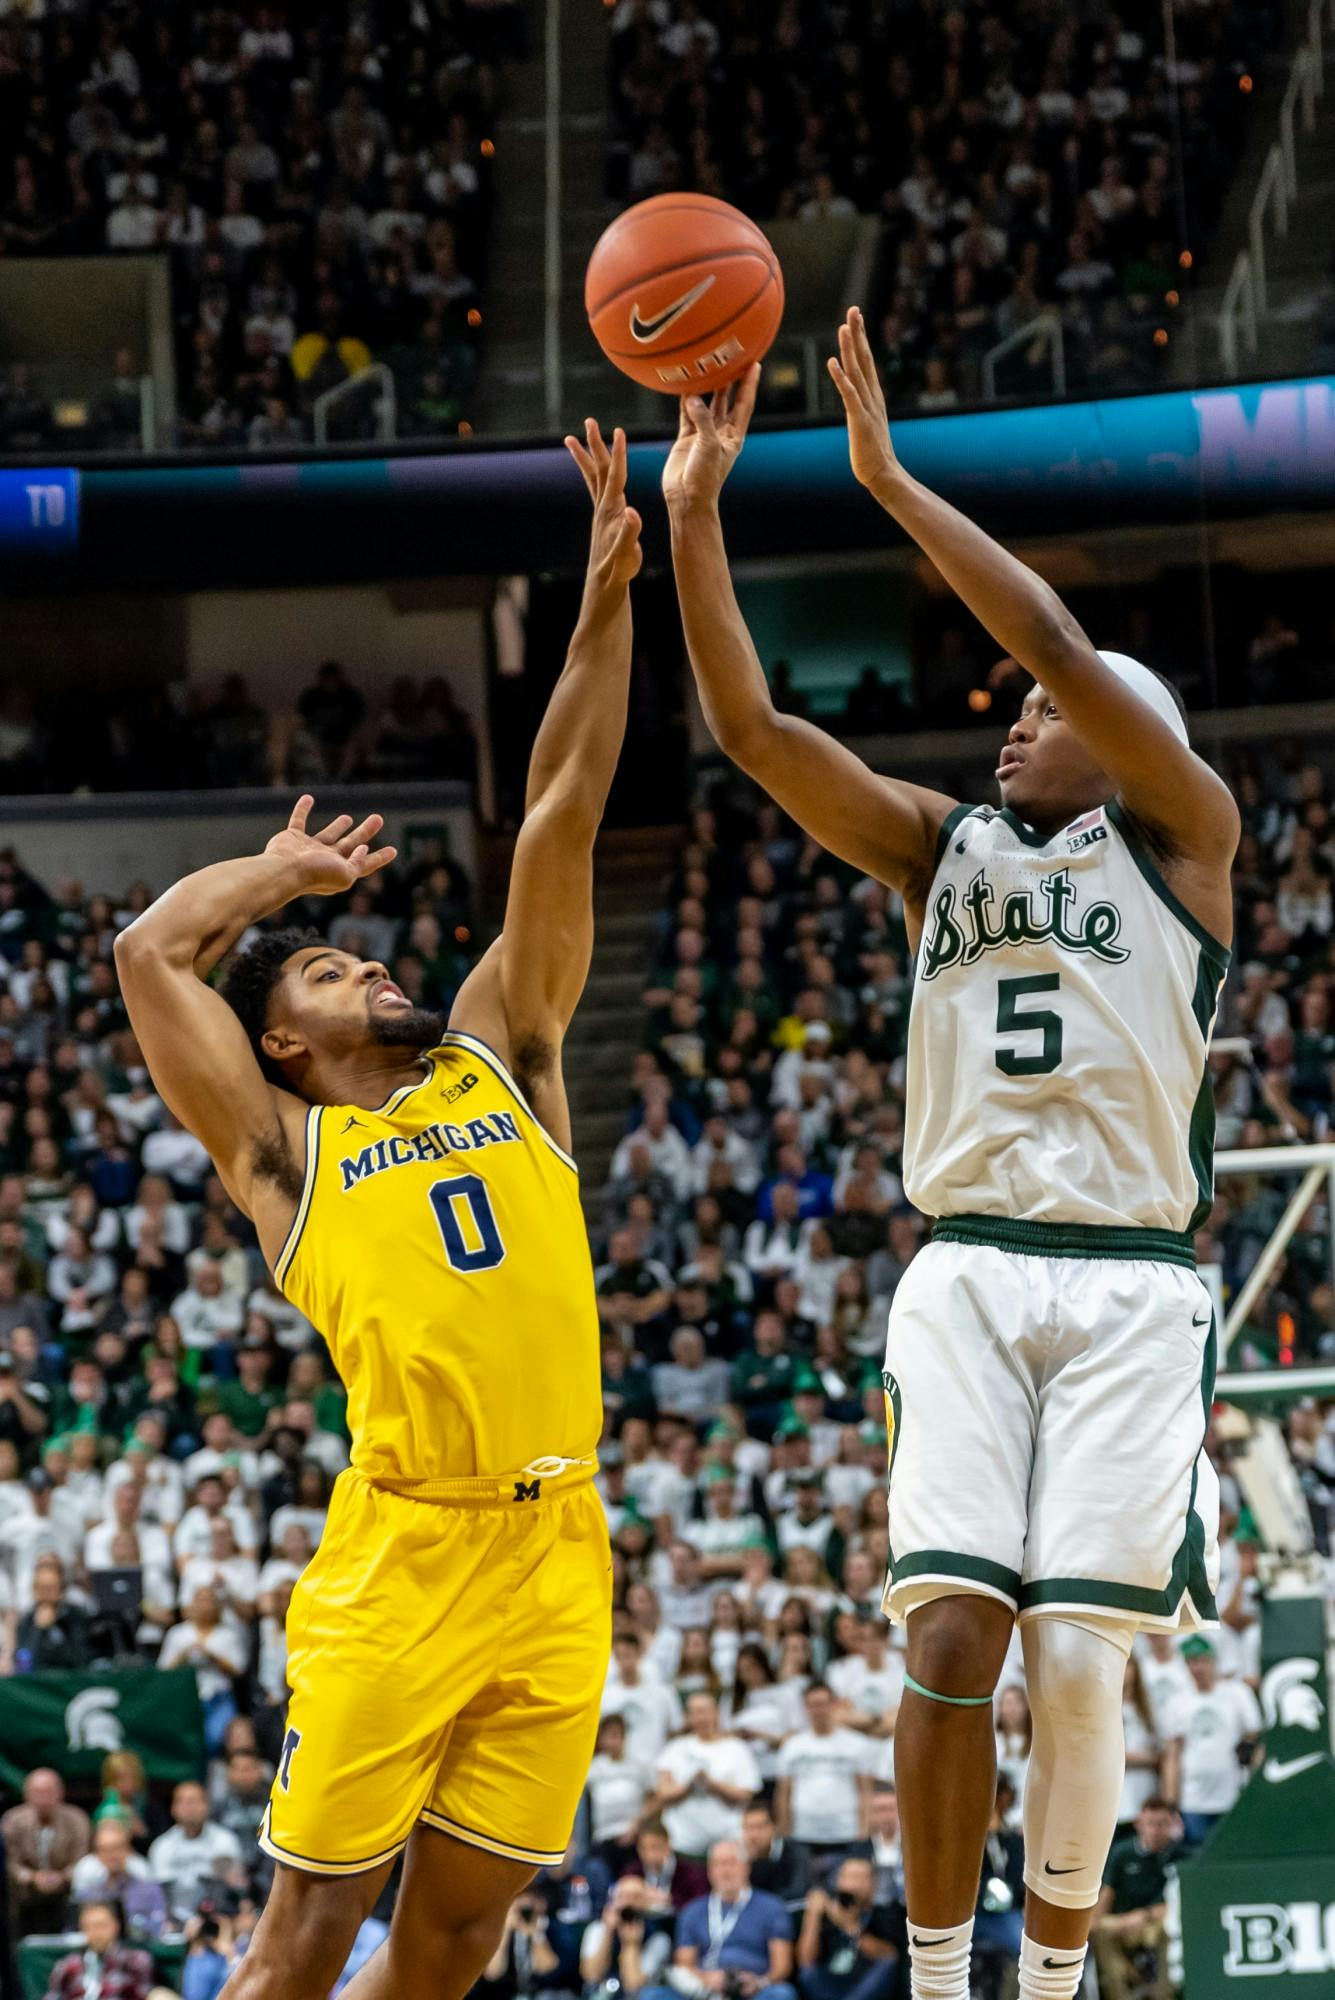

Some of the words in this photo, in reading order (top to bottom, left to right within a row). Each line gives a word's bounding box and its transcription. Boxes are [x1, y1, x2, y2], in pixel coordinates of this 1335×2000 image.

[921, 866, 1131, 981] State
[995, 972, 1063, 1076] 5
[339, 1111, 525, 1193] MICHIGAN
[428, 1172, 507, 1274] 0
[513, 1479, 541, 1502] M
